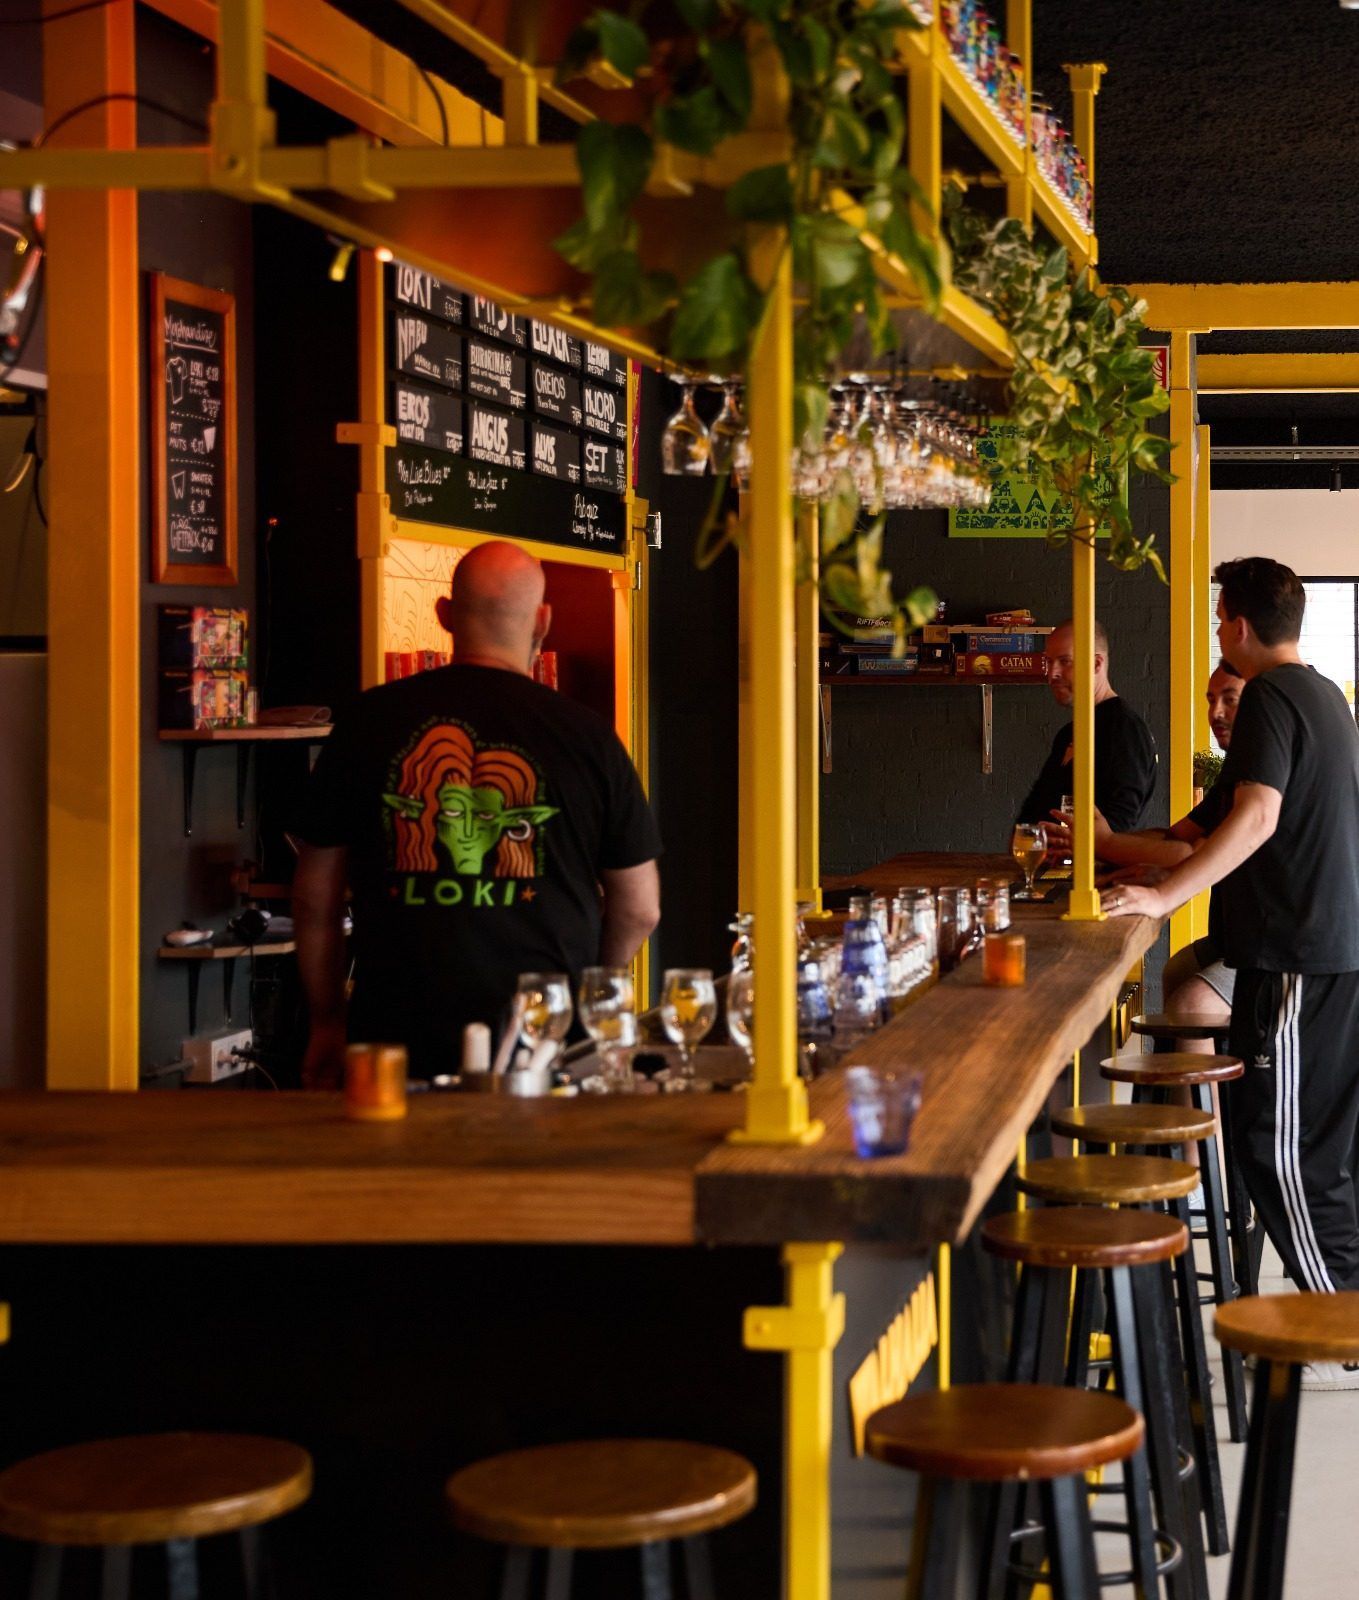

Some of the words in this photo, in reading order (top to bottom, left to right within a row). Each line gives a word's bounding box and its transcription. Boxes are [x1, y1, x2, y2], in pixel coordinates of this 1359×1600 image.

[398, 265, 431, 310] LOKI
[398, 390, 430, 429] EROS
[585, 389, 616, 424] NJORD
[471, 410, 509, 456] ANGUS
[585, 442, 608, 474] SET
[1000, 656, 1032, 668] CATAN
[404, 876, 517, 907] LOKI
